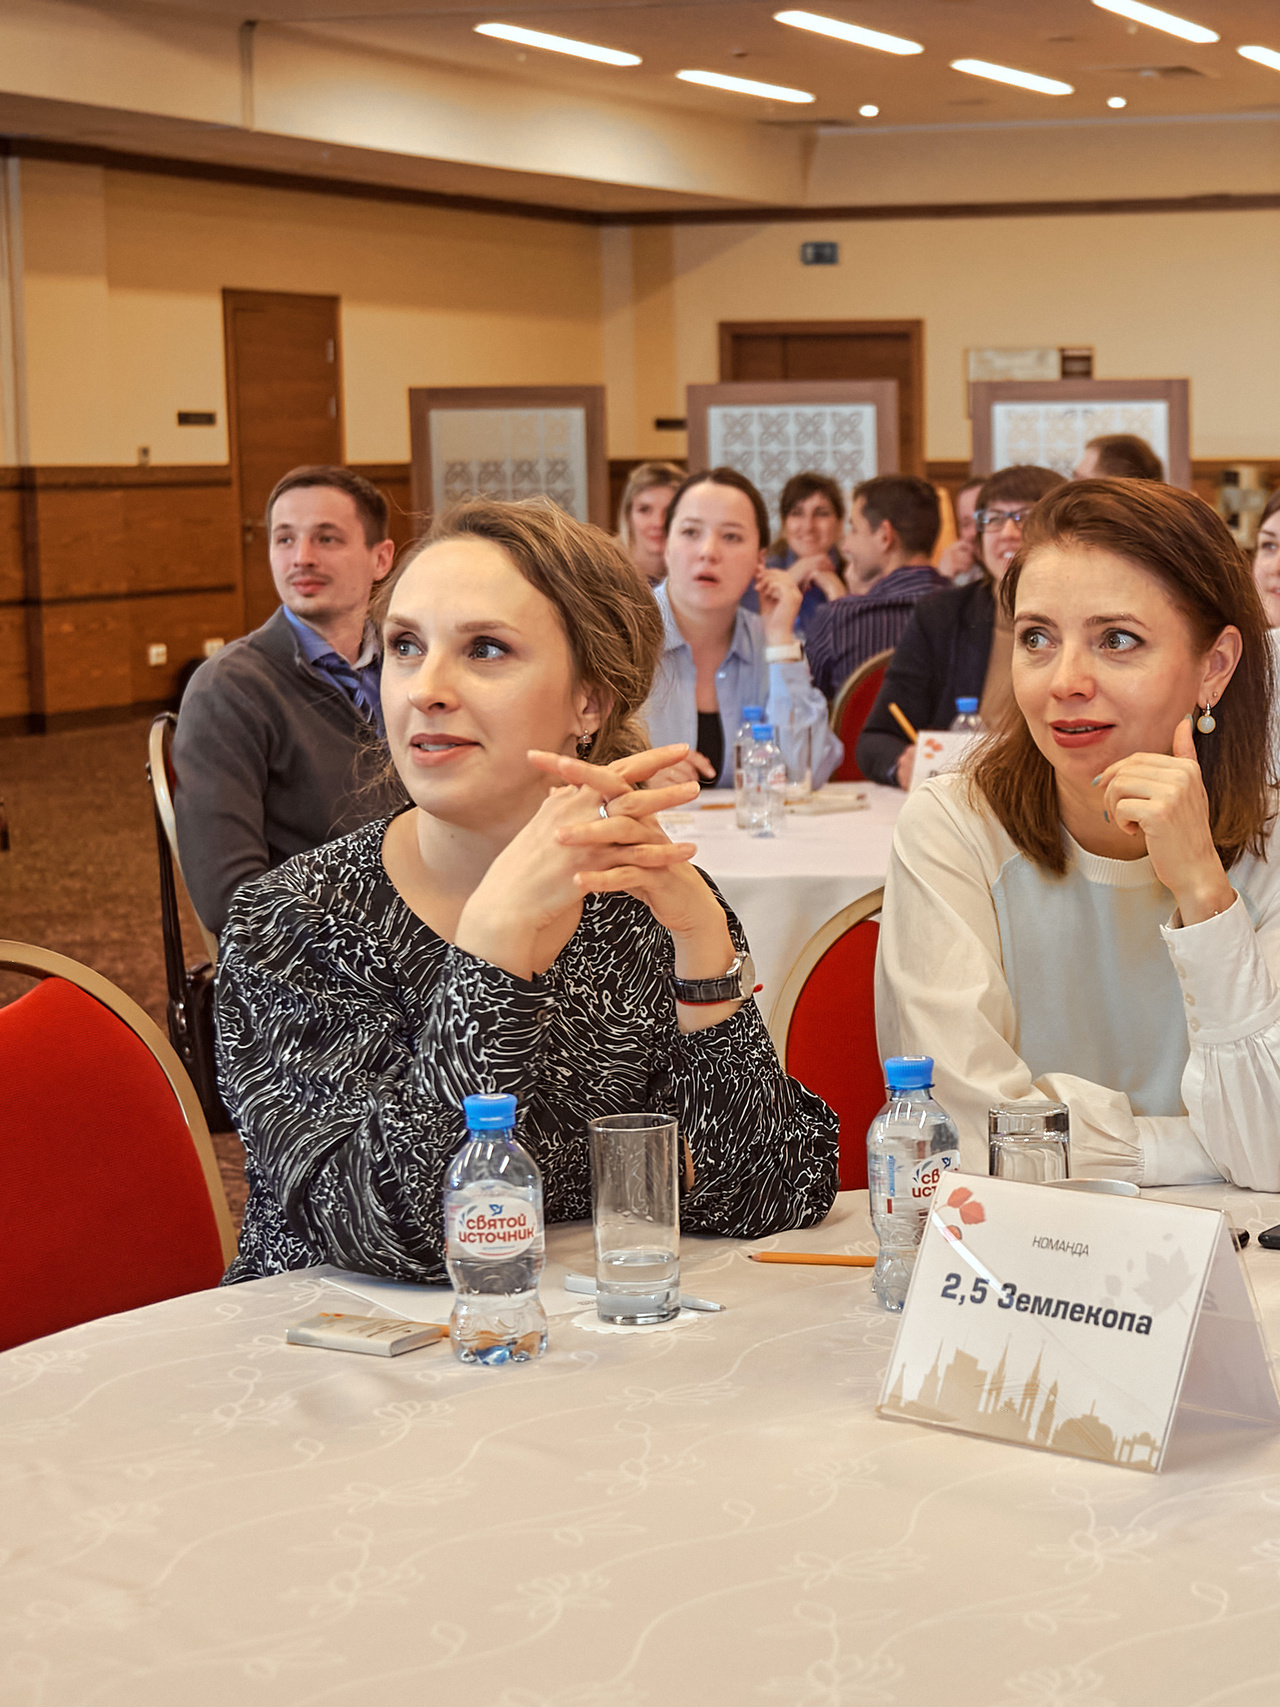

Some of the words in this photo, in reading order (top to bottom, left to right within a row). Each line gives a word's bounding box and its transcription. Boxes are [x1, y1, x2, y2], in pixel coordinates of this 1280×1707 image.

[1032, 1235, 1089, 1257] КОМАНДА
[940, 1272, 990, 1306] 2,5
[997, 1282, 1154, 1336] Землекопа
